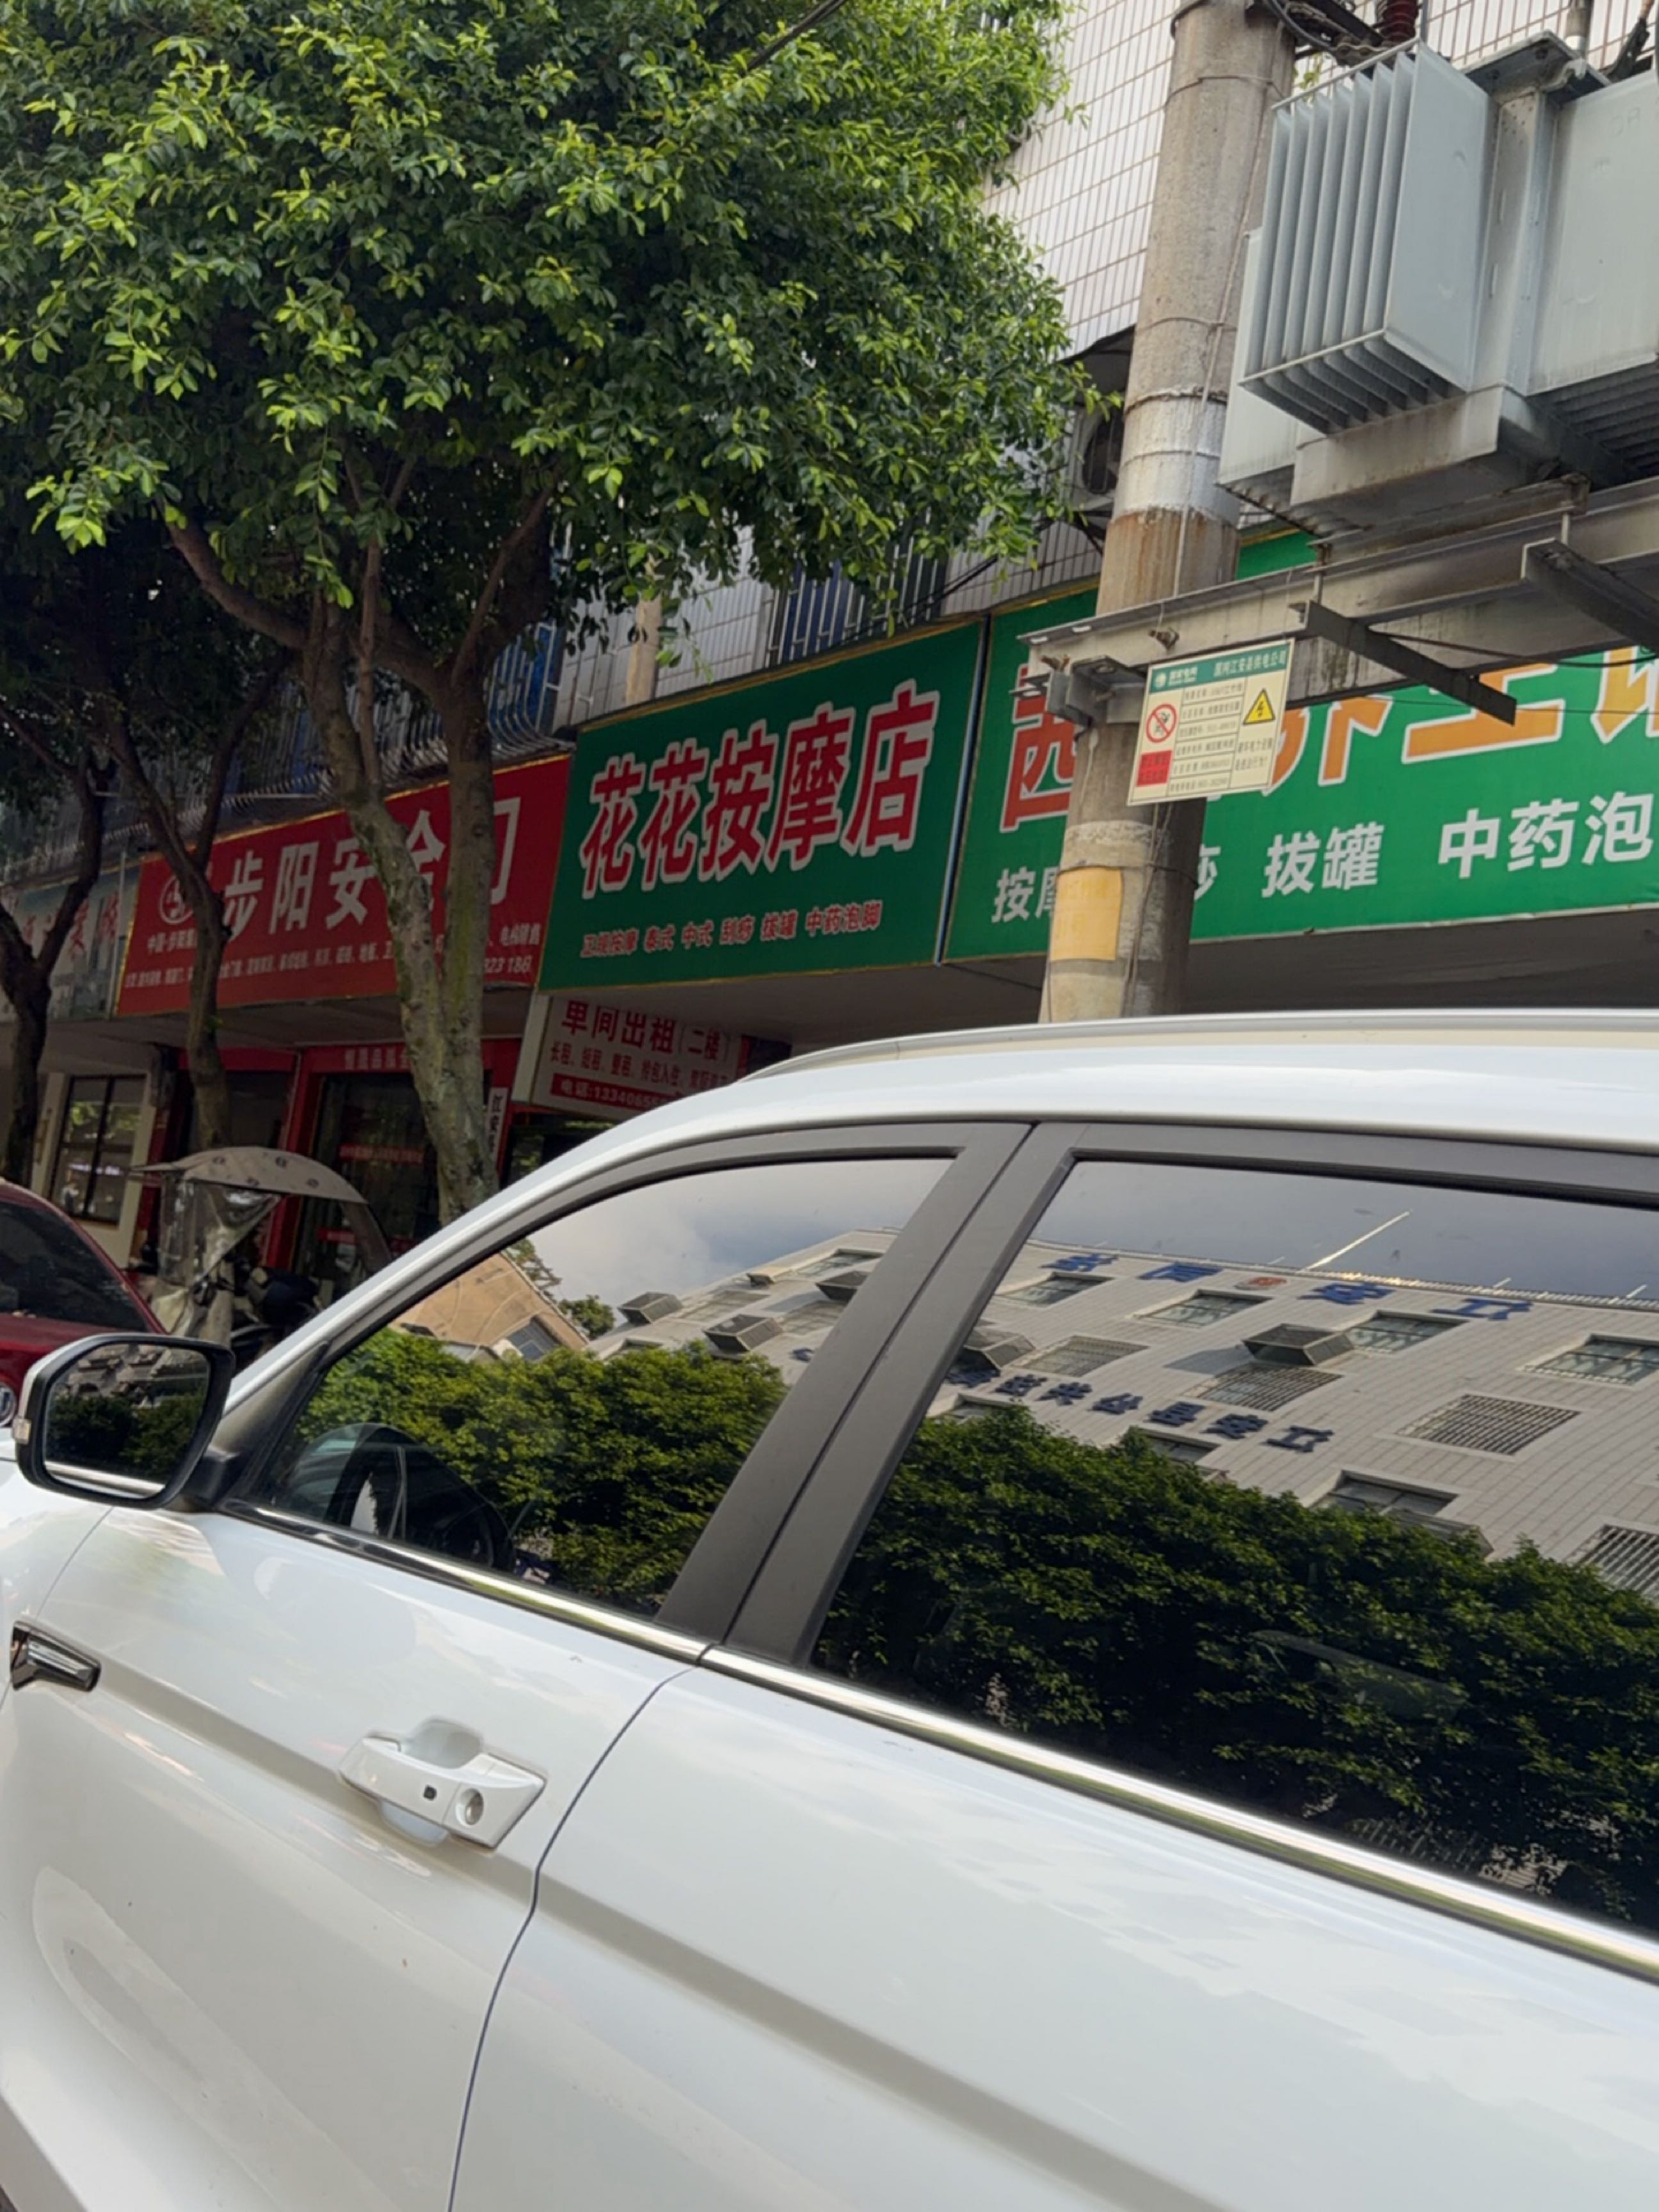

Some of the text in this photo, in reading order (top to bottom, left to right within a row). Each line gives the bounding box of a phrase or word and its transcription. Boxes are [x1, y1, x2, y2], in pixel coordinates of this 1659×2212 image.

[580, 679, 940, 899] 花花按摩店
[1261, 821, 1384, 899] 拔罐
[1438, 790, 1655, 880] 中药泡
[681, 919, 715, 950] 中式
[805, 899, 884, 938] 中药泡脚
